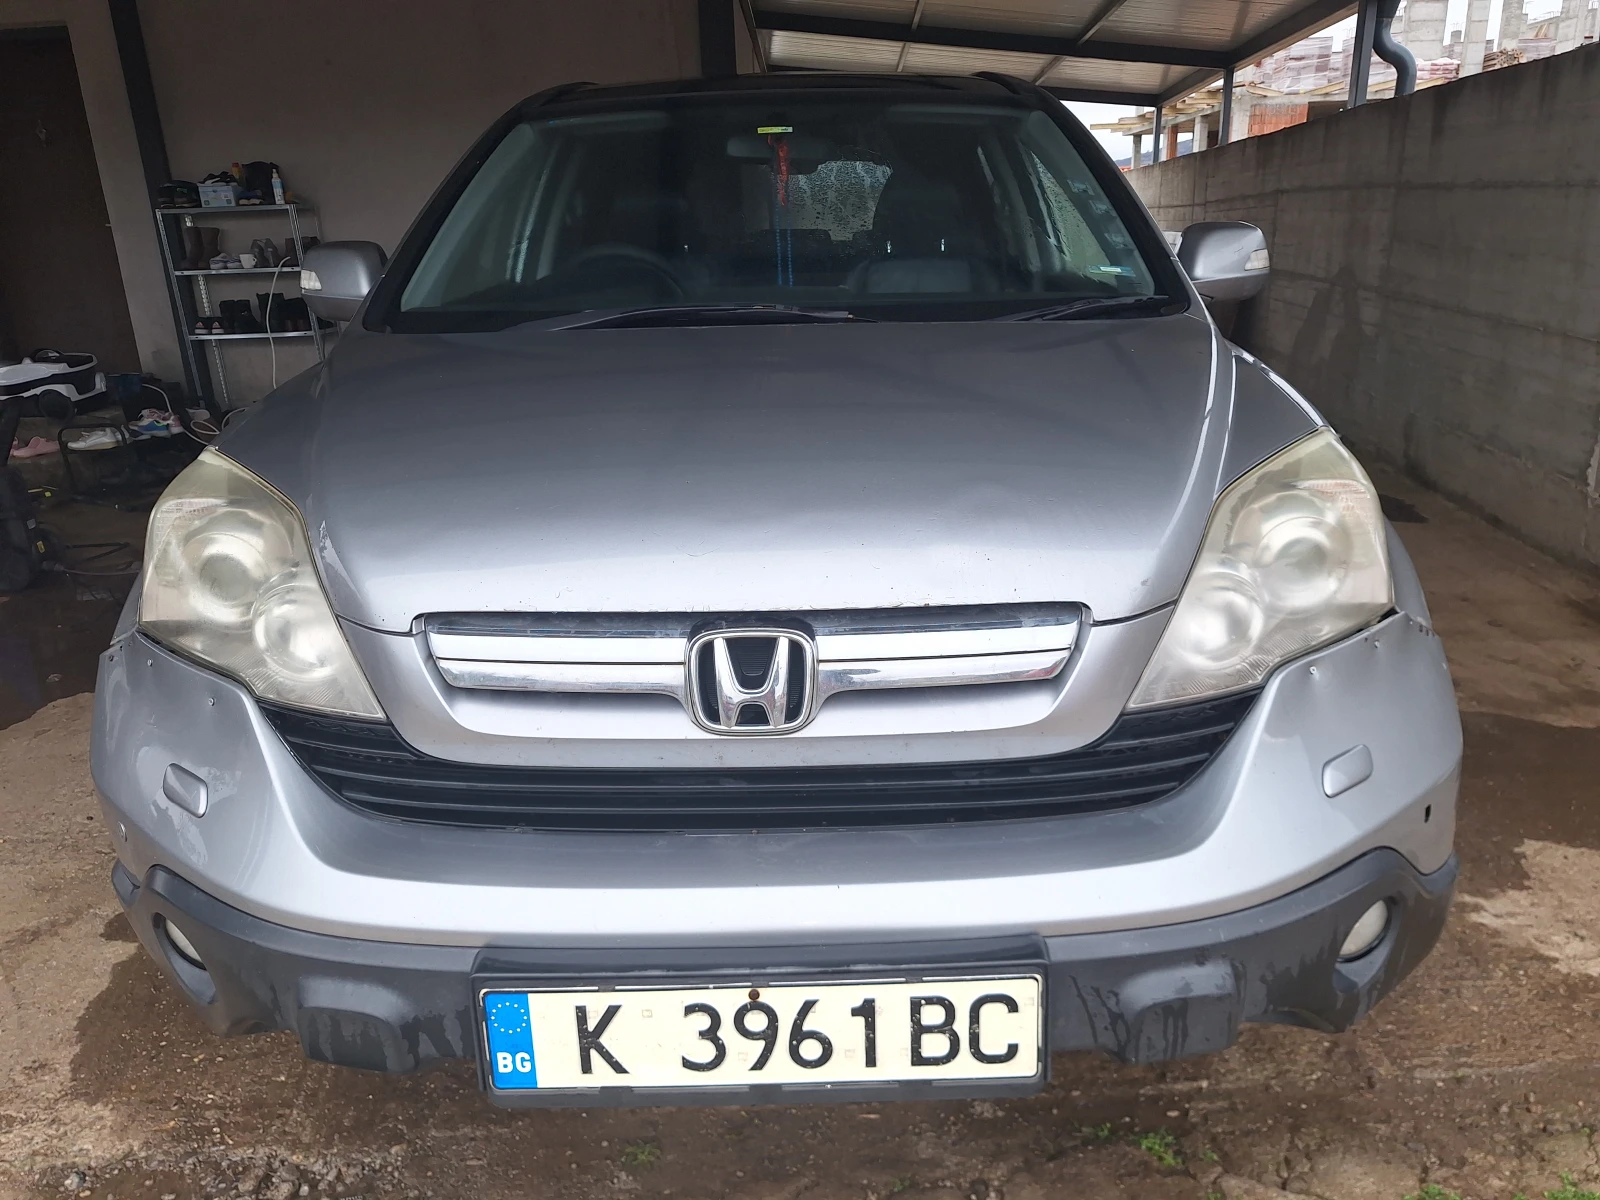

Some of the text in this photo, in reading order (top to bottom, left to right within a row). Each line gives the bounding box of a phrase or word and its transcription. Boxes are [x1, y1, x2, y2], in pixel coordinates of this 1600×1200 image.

[575, 993, 1019, 1075] K 3961 BC
[496, 1052, 532, 1074] BG
